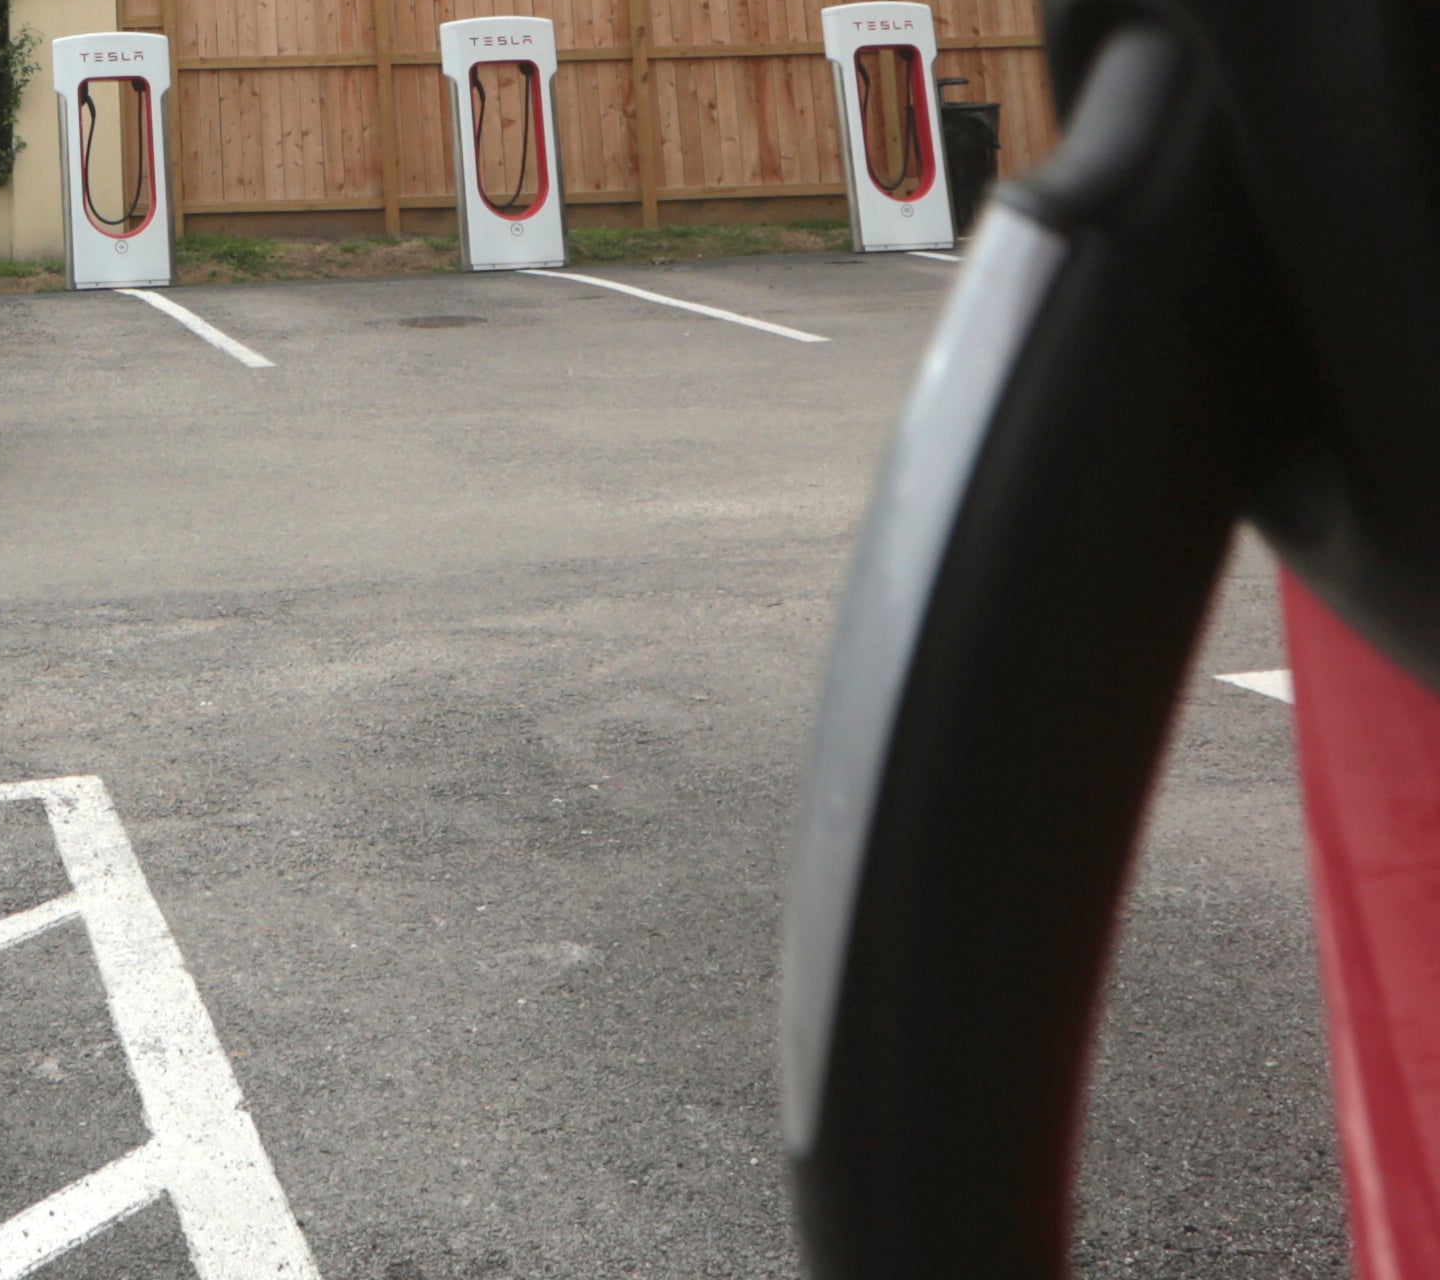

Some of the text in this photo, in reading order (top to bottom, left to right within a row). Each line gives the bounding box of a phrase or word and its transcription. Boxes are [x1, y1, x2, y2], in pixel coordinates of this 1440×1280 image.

[852, 20, 914, 31] TESLA
[468, 35, 533, 47] TESLA
[79, 51, 145, 63] TESLA
